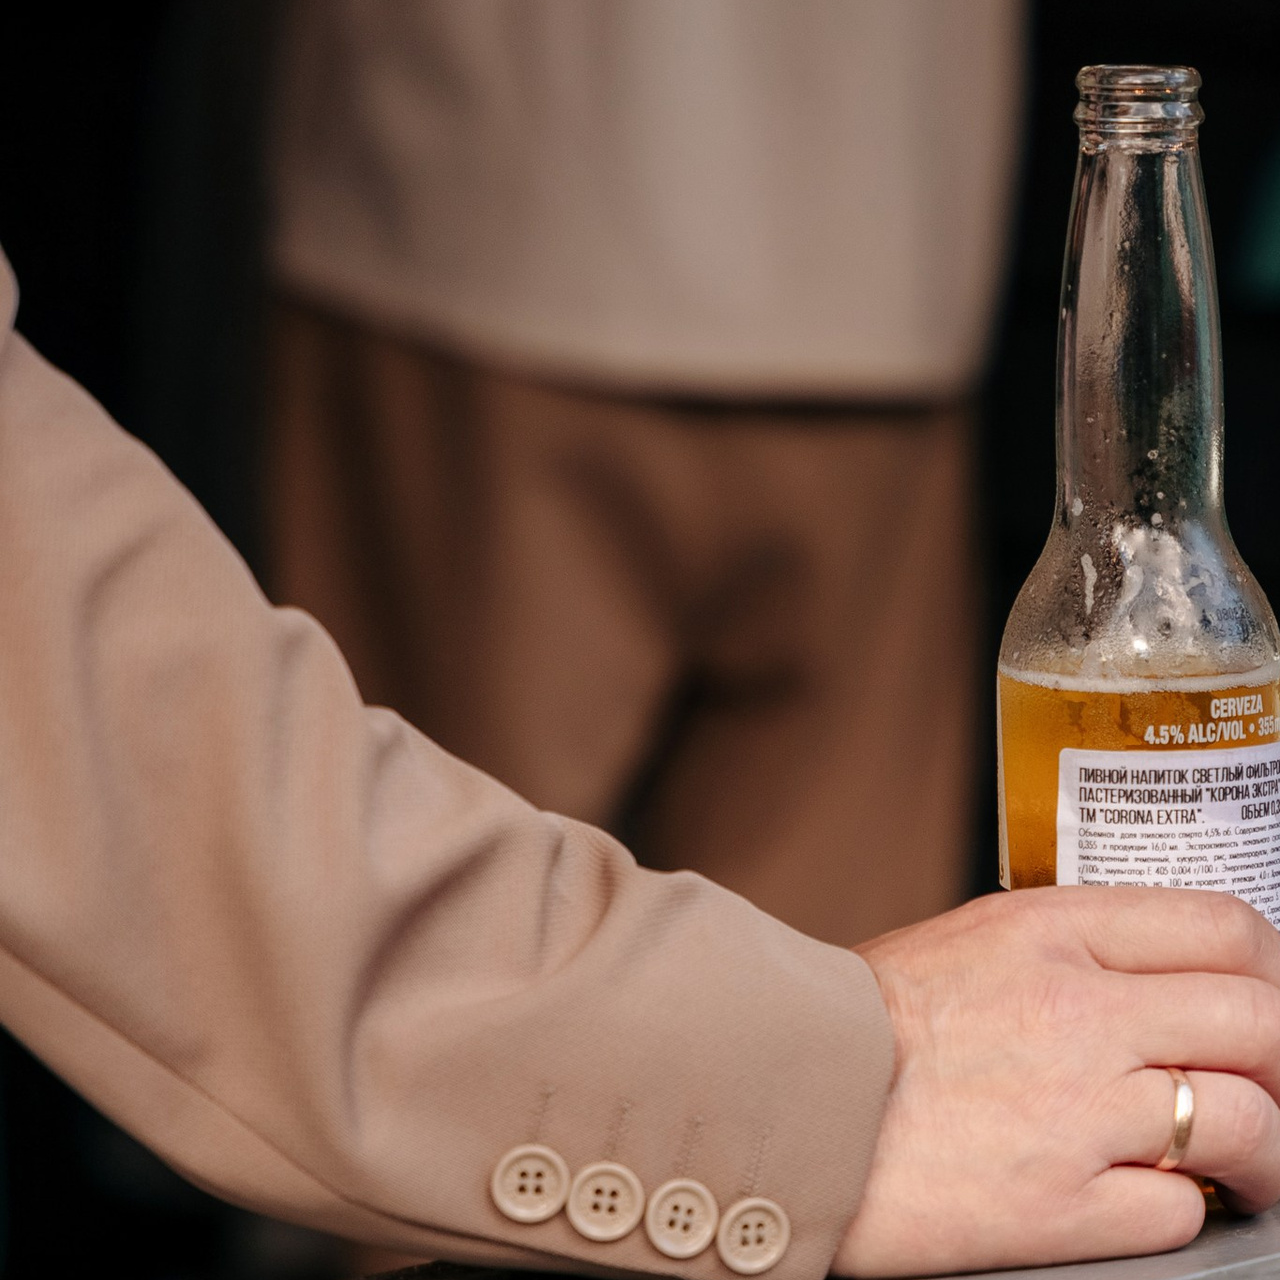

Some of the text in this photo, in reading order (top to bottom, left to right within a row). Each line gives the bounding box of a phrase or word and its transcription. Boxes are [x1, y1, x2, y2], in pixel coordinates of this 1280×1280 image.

[1210, 694, 1263, 719] CERVEZA
[1144, 724, 1185, 745] 4.5%
[1188, 720, 1246, 744] ALC/VOL
[1079, 766, 1127, 784] ПИВНОЙ
[1131, 769, 1189, 785] НАПИТОК
[1192, 763, 1244, 784] СВЕТЛЫЙ
[1079, 785, 1203, 805] ПАСТЕРИЗОВАННЫЙ
[1205, 784, 1250, 802] "КОРОНА
[1079, 807, 1096, 823] ТМ
[1099, 809, 1154, 824] "CORONA
[1157, 809, 1205, 824] EXTRA".
[1241, 802, 1270, 820] ОБЪЕМ
[1178, 831, 1203, 840] спирта
[1204, 828, 1221, 838] 4,5%
[1078, 840, 1098, 850] 0,355
[1109, 844, 1148, 852] продукции
[1151, 842, 1167, 852] 16,0
[1185, 841, 1239, 852] Экстрактивность
[1104, 868, 1145, 877] эмульгатор
[1155, 866, 1169, 875] 405
[1171, 866, 1191, 876] 0,004
[1193, 865, 1213, 875] г/100
[1169, 878, 1182, 887] 100
